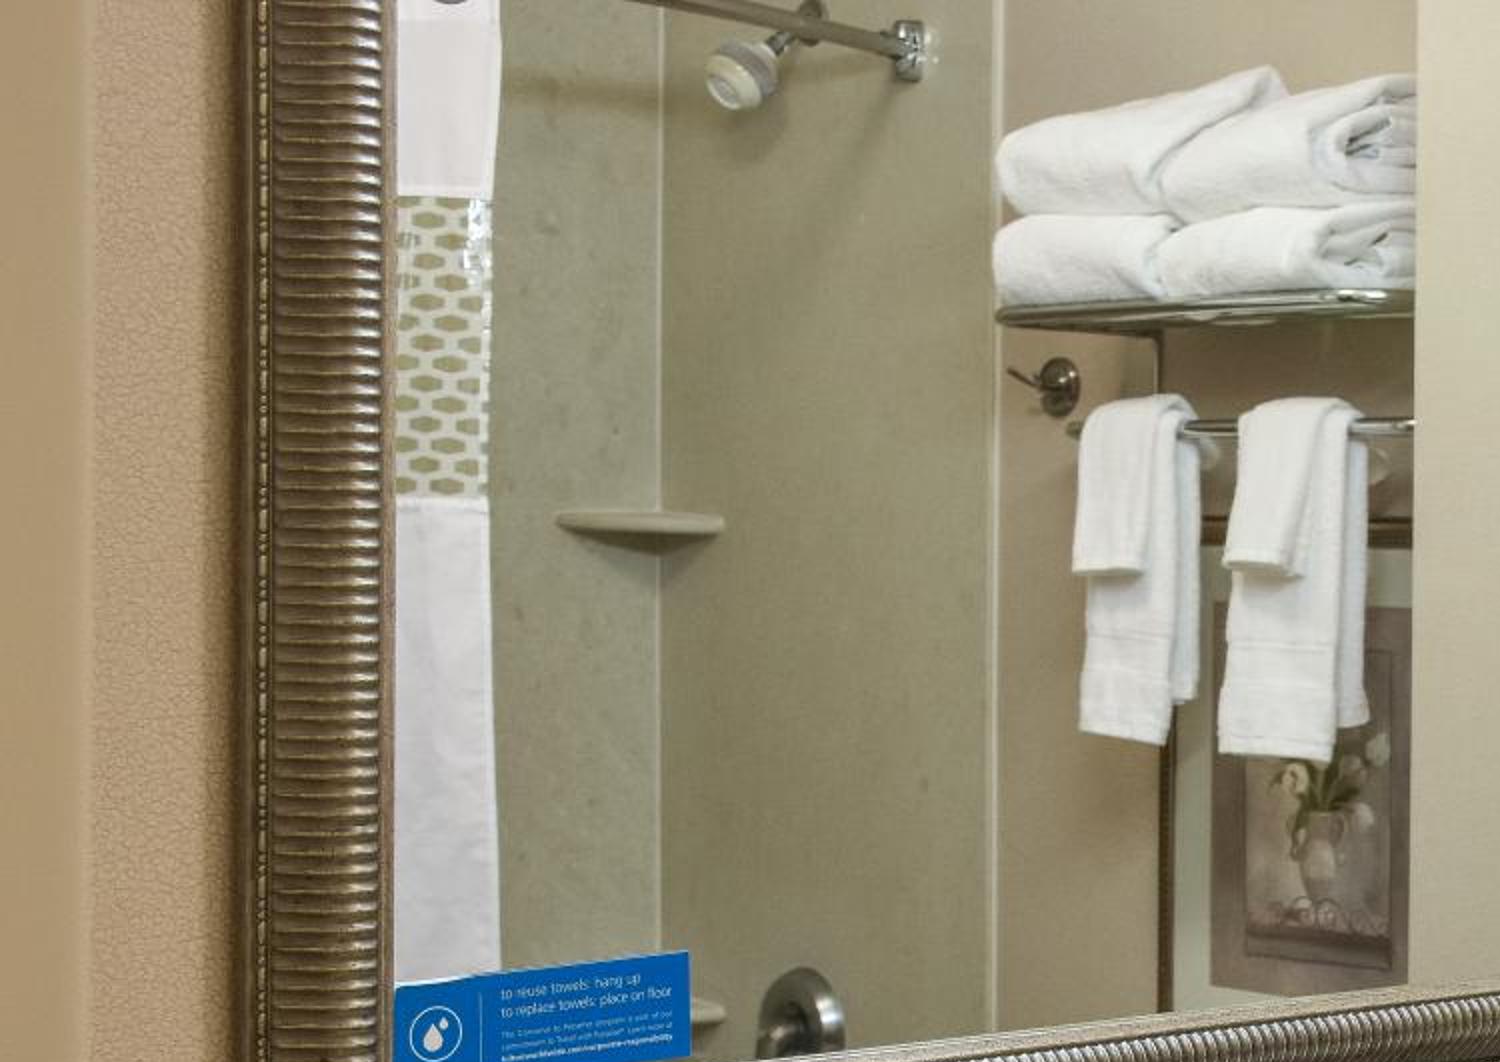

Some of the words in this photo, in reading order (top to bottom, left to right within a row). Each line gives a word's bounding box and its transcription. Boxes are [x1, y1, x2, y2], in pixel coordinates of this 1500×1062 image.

[501, 989, 512, 1000] to
[517, 986, 547, 998] reuse
[595, 976, 623, 989] hang
[627, 974, 641, 987] up
[501, 1007, 513, 1018] to
[515, 1001, 556, 1017] replace
[599, 992, 629, 1009] place
[630, 990, 645, 1001] on
[647, 987, 673, 1000] floor
